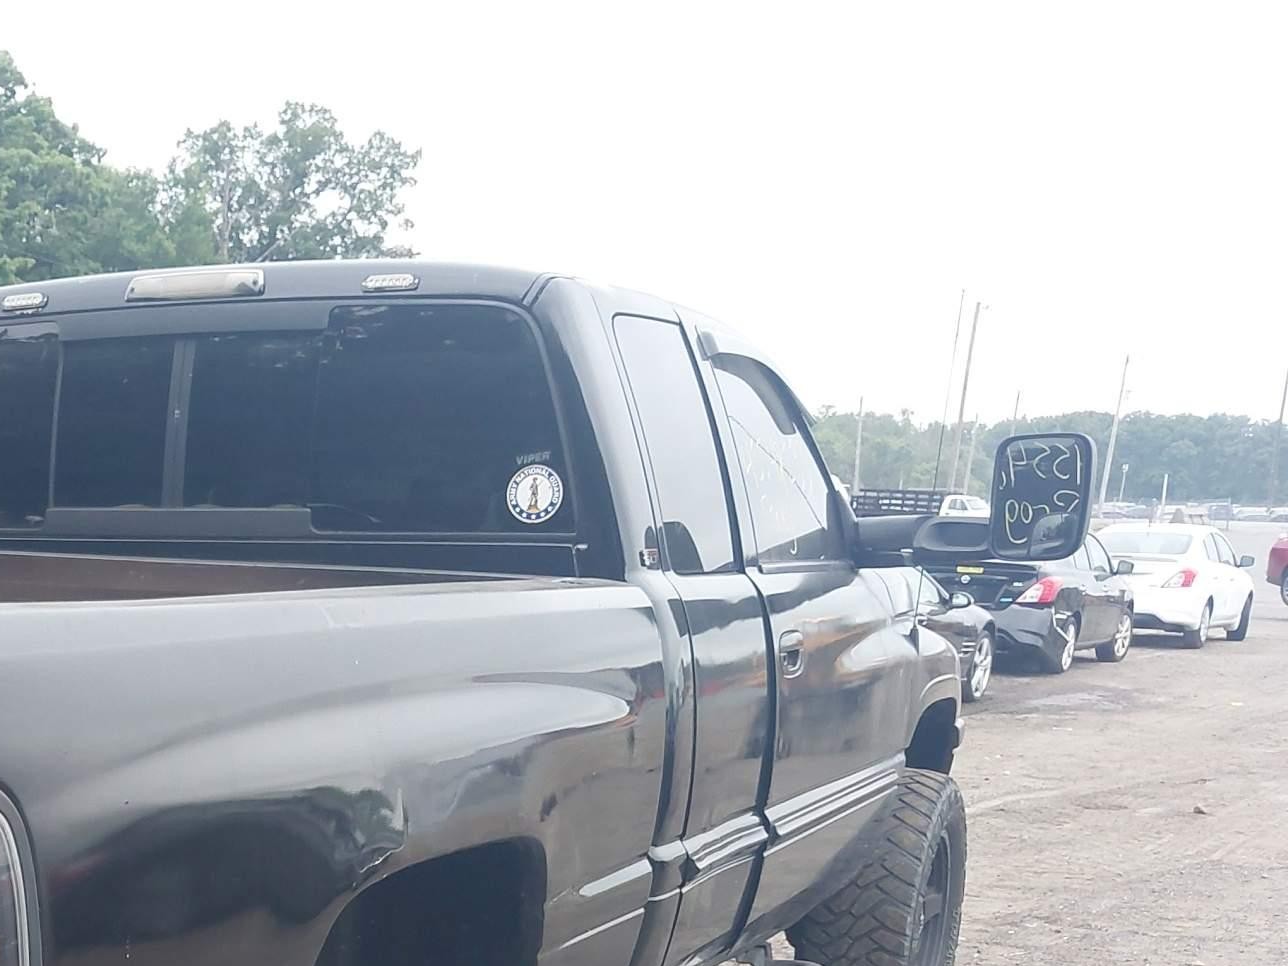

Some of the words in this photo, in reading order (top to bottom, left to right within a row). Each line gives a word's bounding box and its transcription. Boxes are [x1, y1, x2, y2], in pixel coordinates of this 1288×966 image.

[515, 450, 552, 465] VIPER
[508, 482, 518, 506] ARMY
[515, 466, 550, 484] NATIONAL
[549, 475, 561, 504] GUARD
